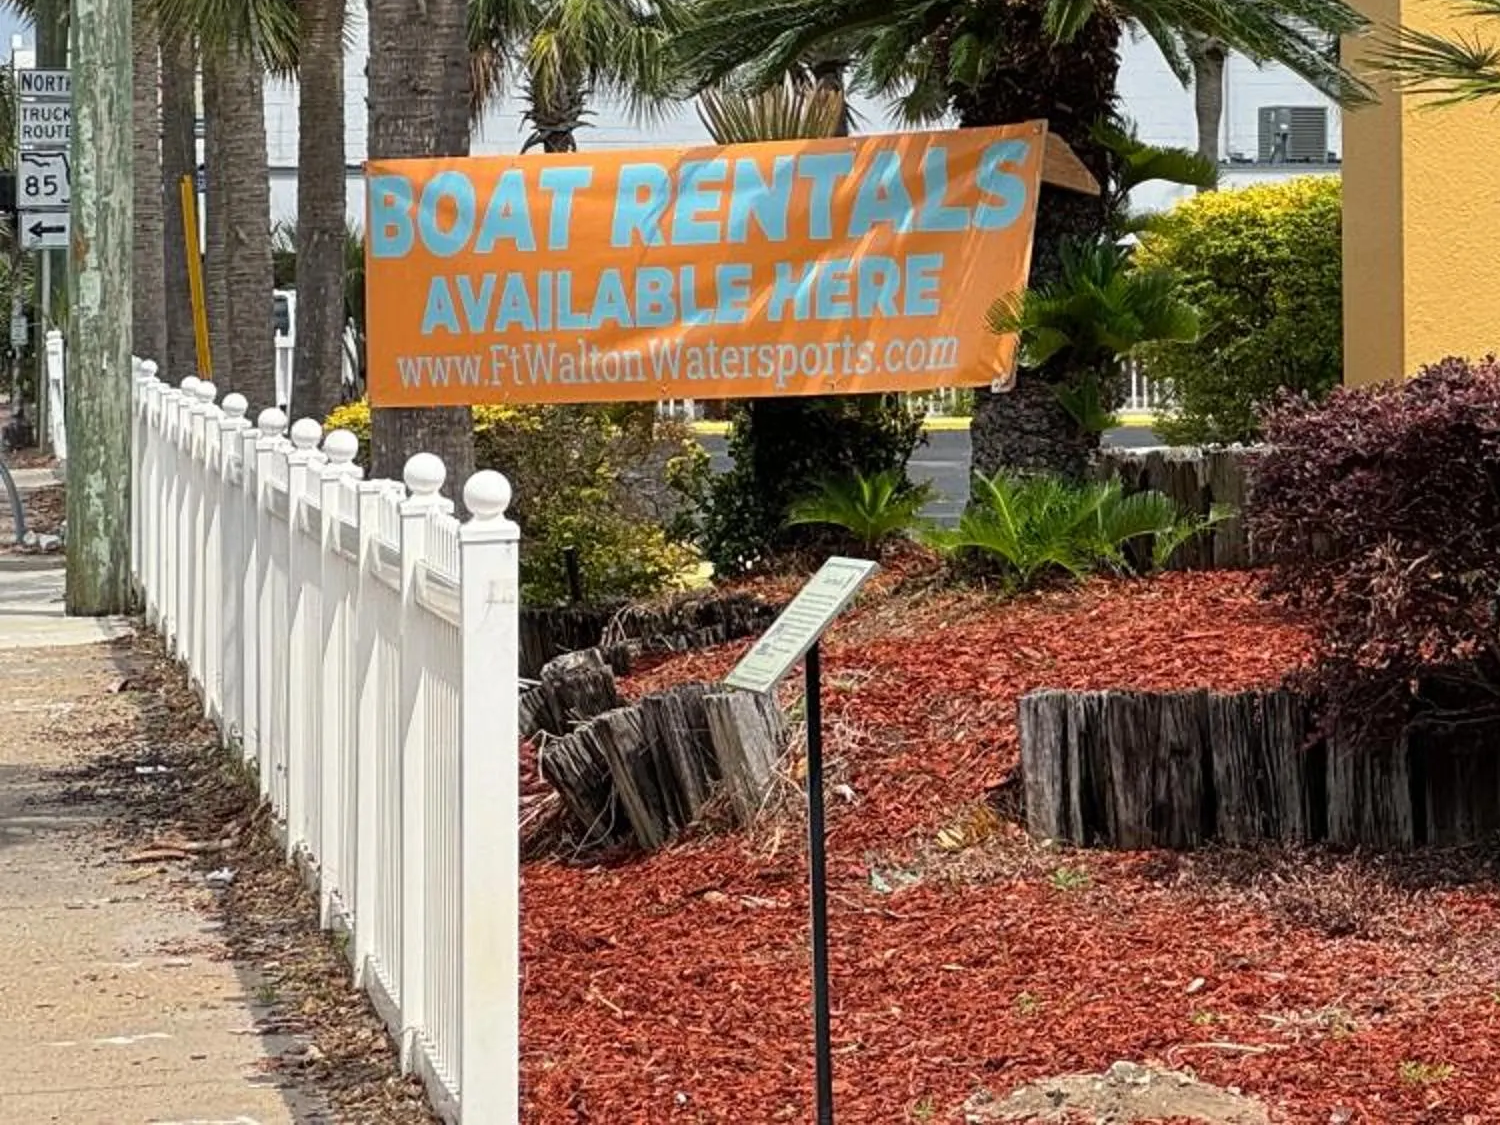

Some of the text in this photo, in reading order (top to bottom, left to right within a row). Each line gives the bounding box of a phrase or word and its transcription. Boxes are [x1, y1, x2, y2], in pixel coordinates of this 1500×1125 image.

[22, 106, 71, 121] TRUCK
[23, 125, 70, 138] ROUTE
[25, 175, 58, 196] 85
[369, 137, 1030, 259] BOAT RENTALS
[421, 252, 944, 335] AVAILABLE HERE
[397, 333, 959, 390] www.FtWaltonWatersports.com
